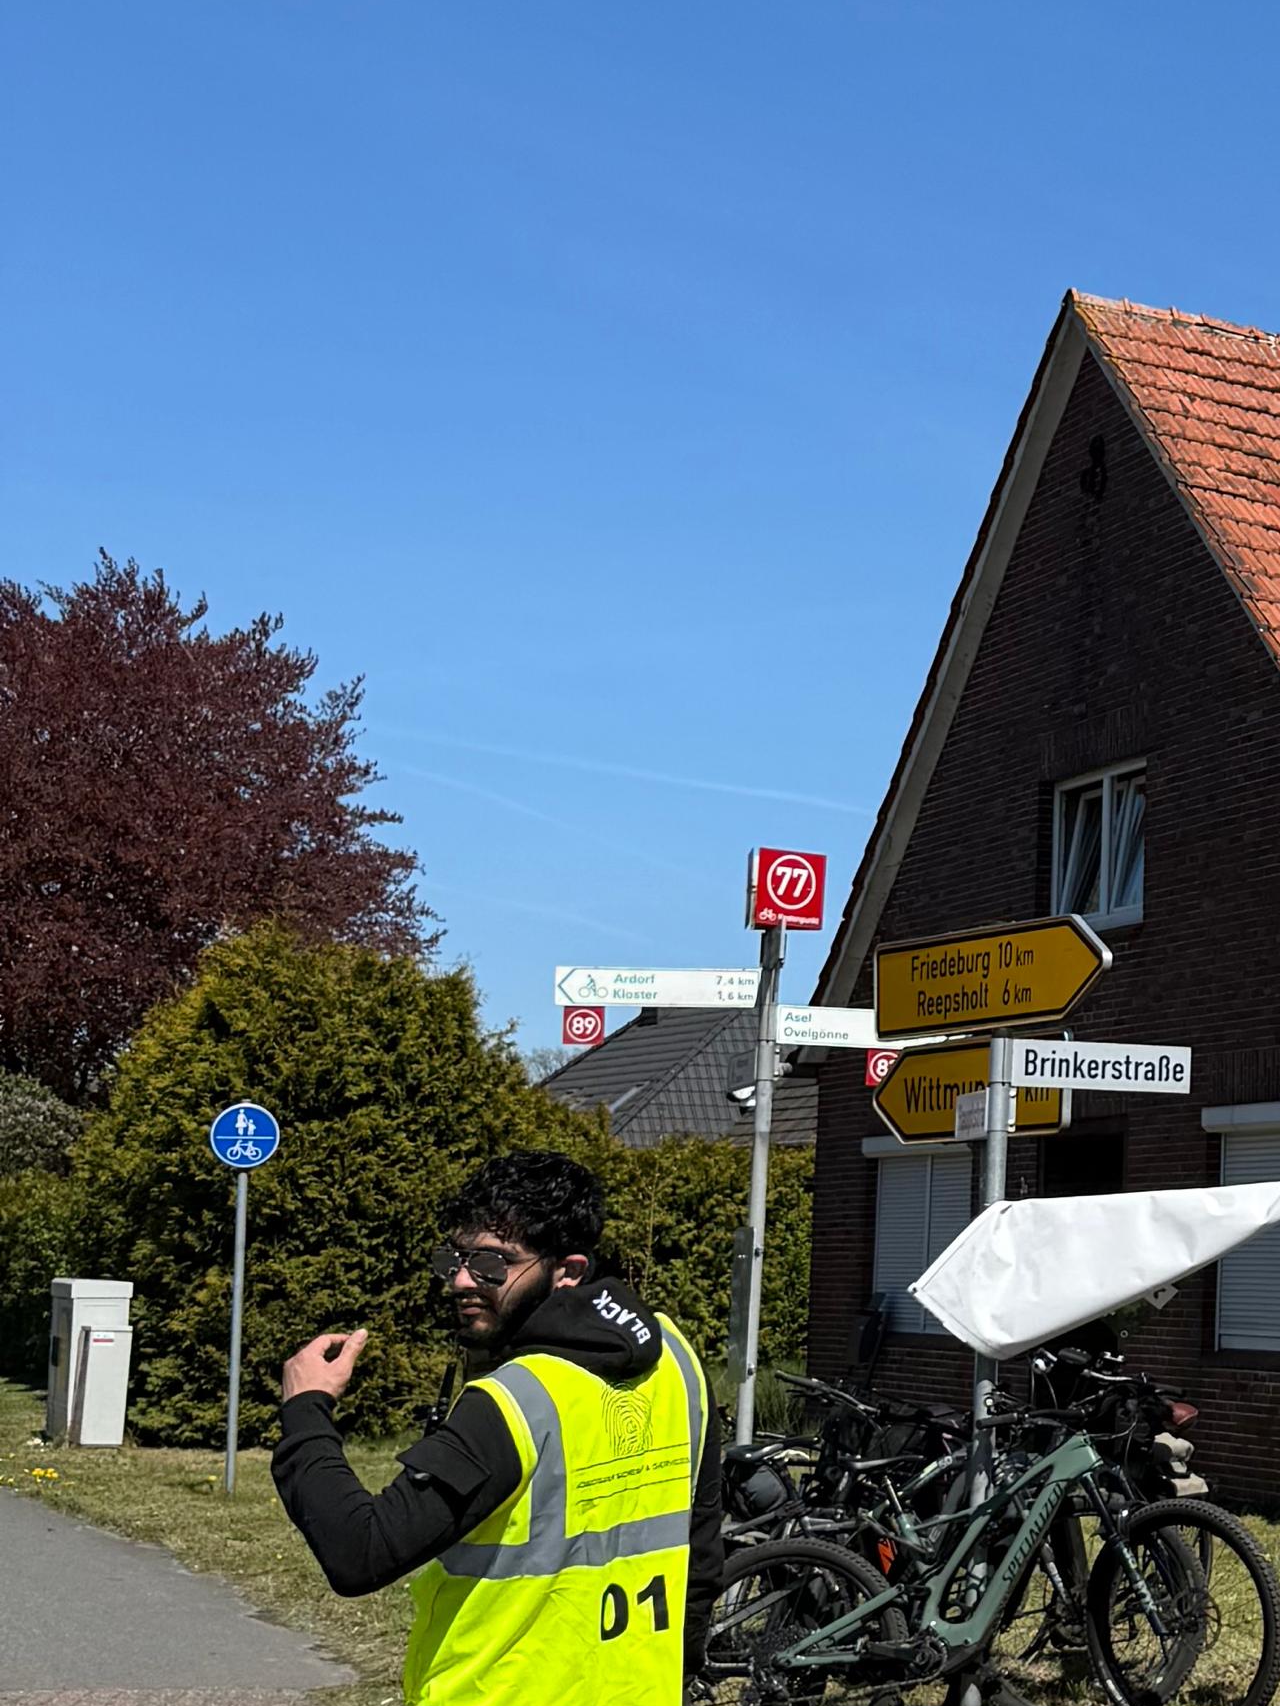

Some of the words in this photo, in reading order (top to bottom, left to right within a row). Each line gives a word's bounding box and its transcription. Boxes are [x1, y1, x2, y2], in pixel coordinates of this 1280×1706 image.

[776, 866, 808, 898] 77
[911, 949, 991, 982] Friedeburg
[998, 941, 1013, 969] 10
[1016, 946, 1034, 967] km
[612, 988, 658, 999] Kloster
[738, 992, 754, 1001] km
[613, 973, 655, 984] Ardorf
[738, 976, 755, 986] km
[917, 982, 989, 1021] Reepsholt
[1002, 979, 1010, 1006] 6
[1014, 984, 1032, 1004] km
[571, 1016, 596, 1035] 89
[783, 1026, 849, 1041] Ovelgönne
[784, 1012, 812, 1023] Asel
[1023, 1048, 1185, 1083] Brinkerstraße
[592, 1289, 651, 1345] BLACK
[600, 1574, 670, 1642] 01
